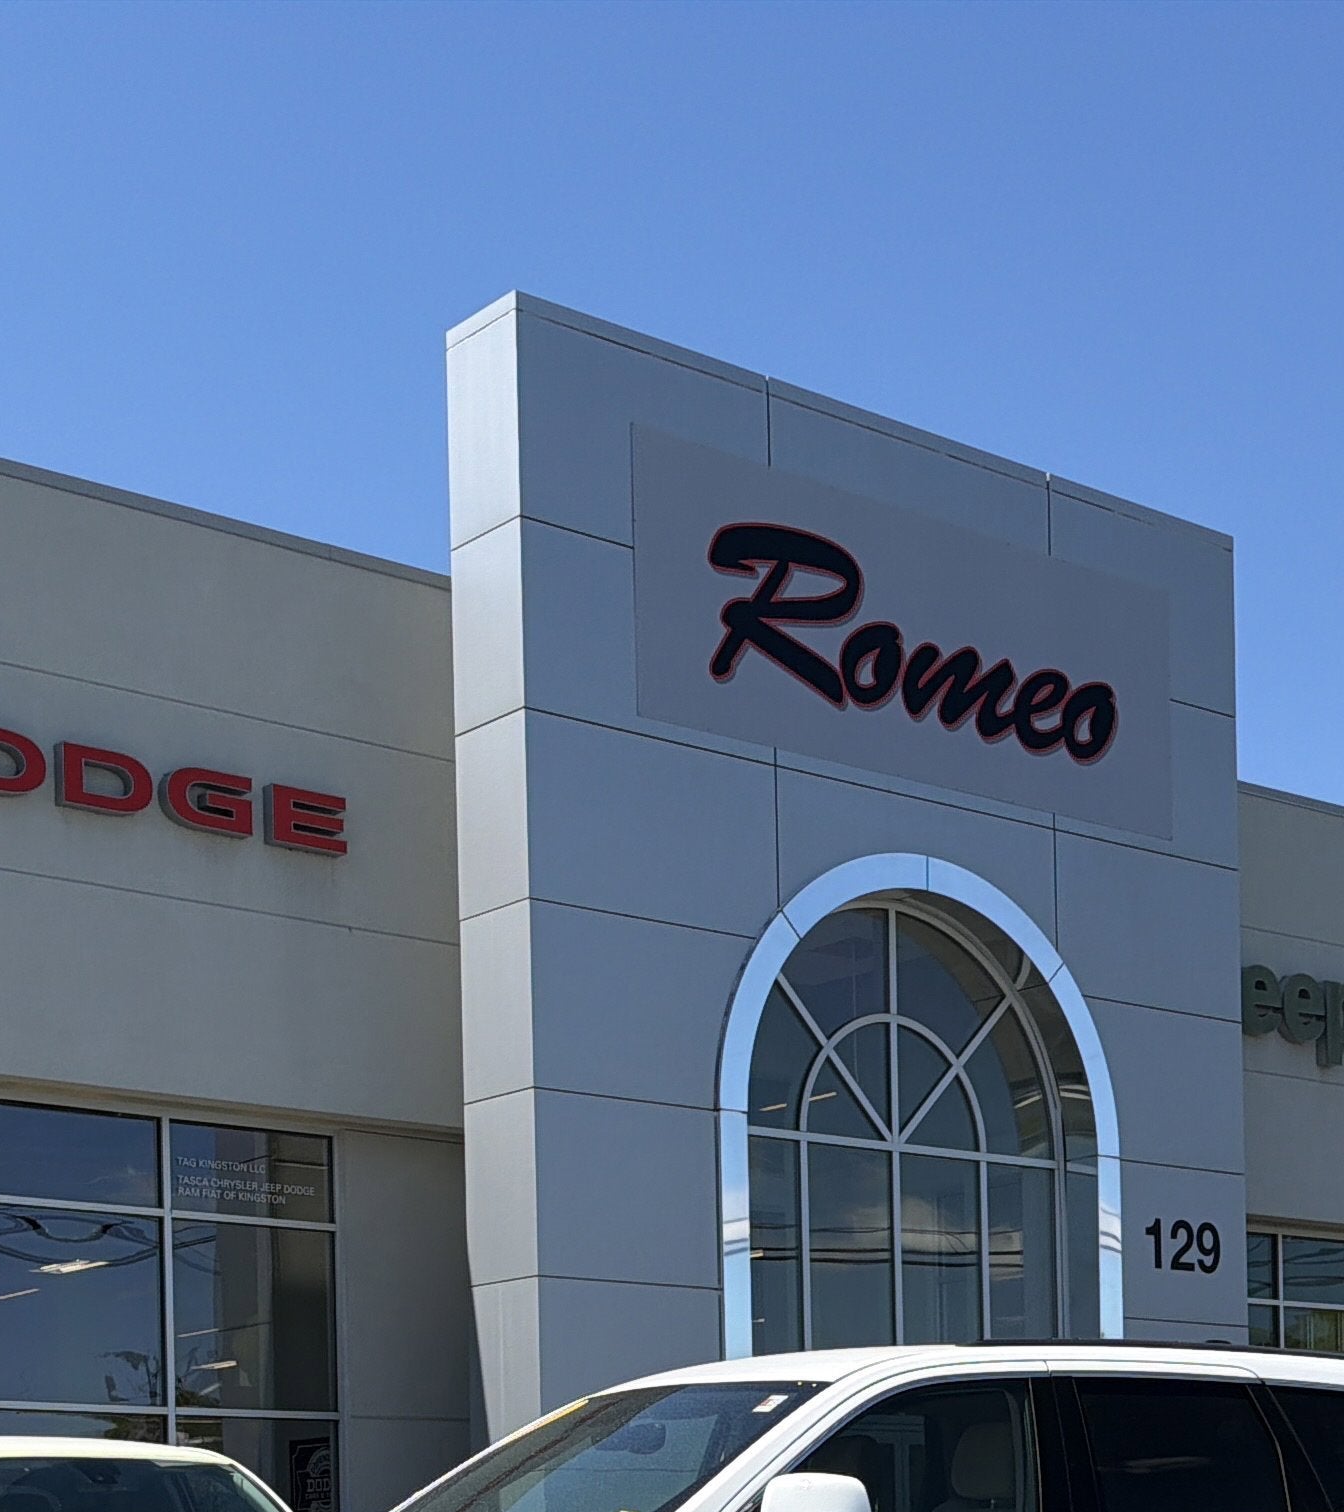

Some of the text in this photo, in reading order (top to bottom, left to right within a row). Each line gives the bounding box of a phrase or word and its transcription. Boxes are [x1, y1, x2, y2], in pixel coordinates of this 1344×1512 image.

[708, 522, 1119, 766] Romeo
[177, 1157, 266, 1174] TAG KINGSTON LLC
[177, 1175, 315, 1196] TASCA CHRYSLER JEEP DODGE
[177, 1186, 287, 1204] RAM FIAT OF KINGSTON
[1145, 1218, 1221, 1274] 129
[306, 1478, 331, 1493] DOD
